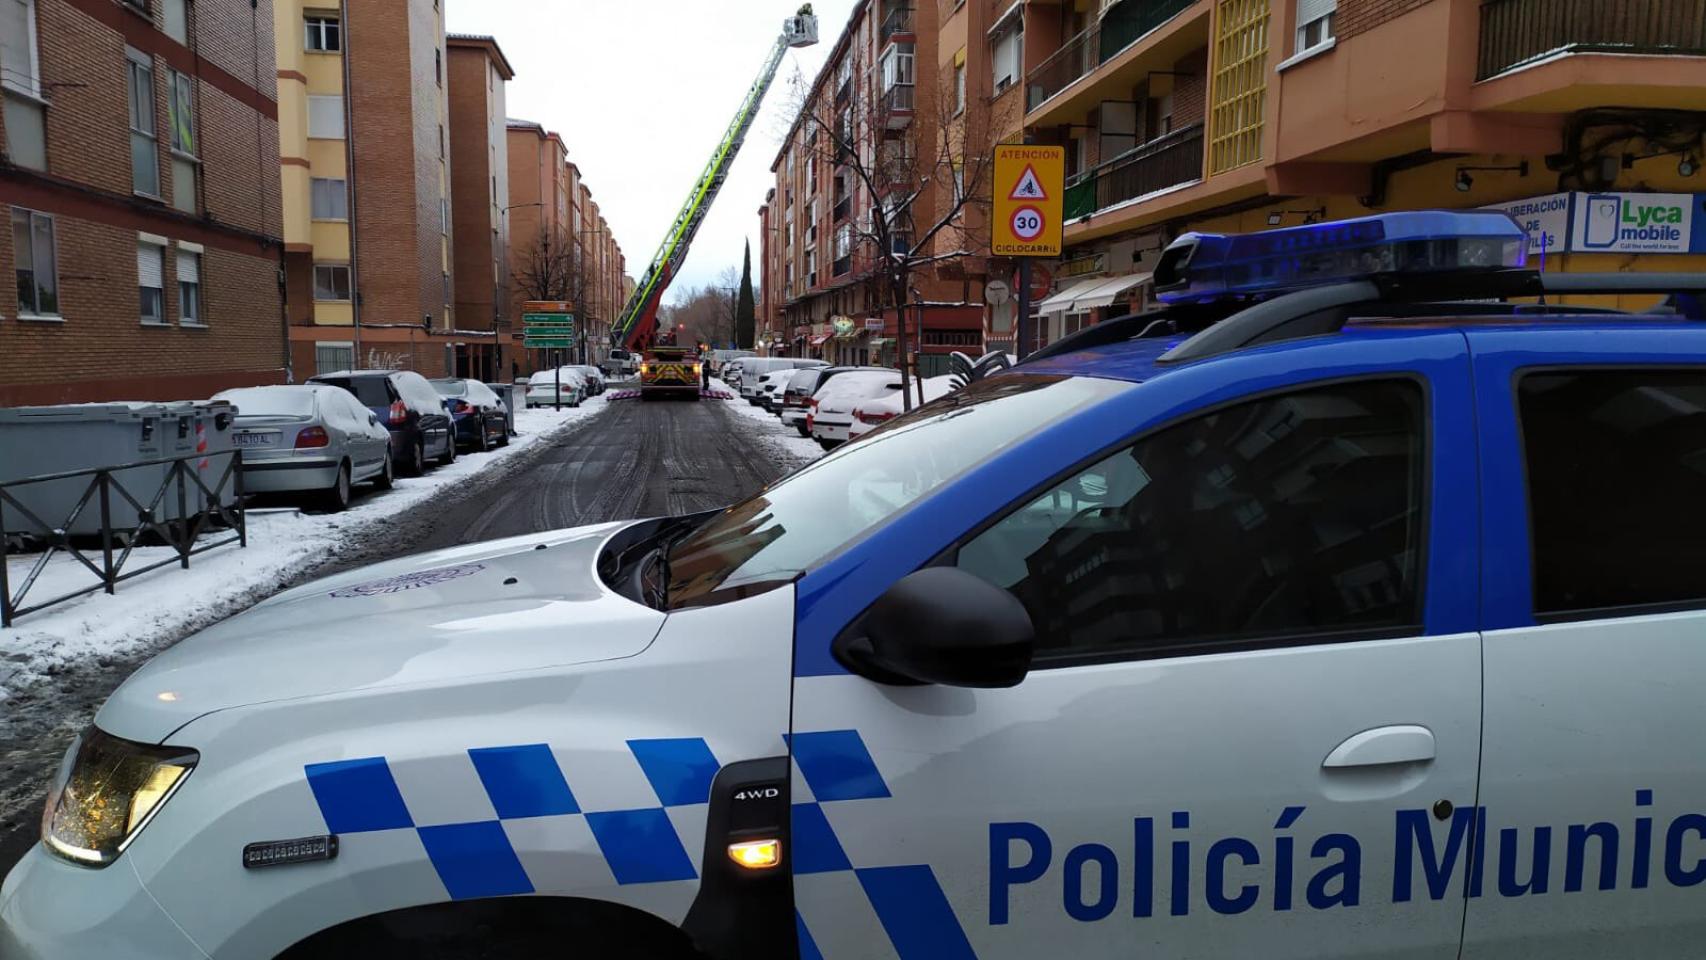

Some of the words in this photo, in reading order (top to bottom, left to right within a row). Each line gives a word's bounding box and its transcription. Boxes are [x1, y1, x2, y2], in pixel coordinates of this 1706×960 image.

[1622, 200, 1682, 228] Lyca
[1016, 216, 1038, 230] 30
[1526, 220, 1541, 231] DE
[1621, 226, 1680, 241] mobile
[735, 788, 779, 800] 4WD
[989, 806, 1362, 925] Policía
[1393, 789, 1706, 904] Munic
